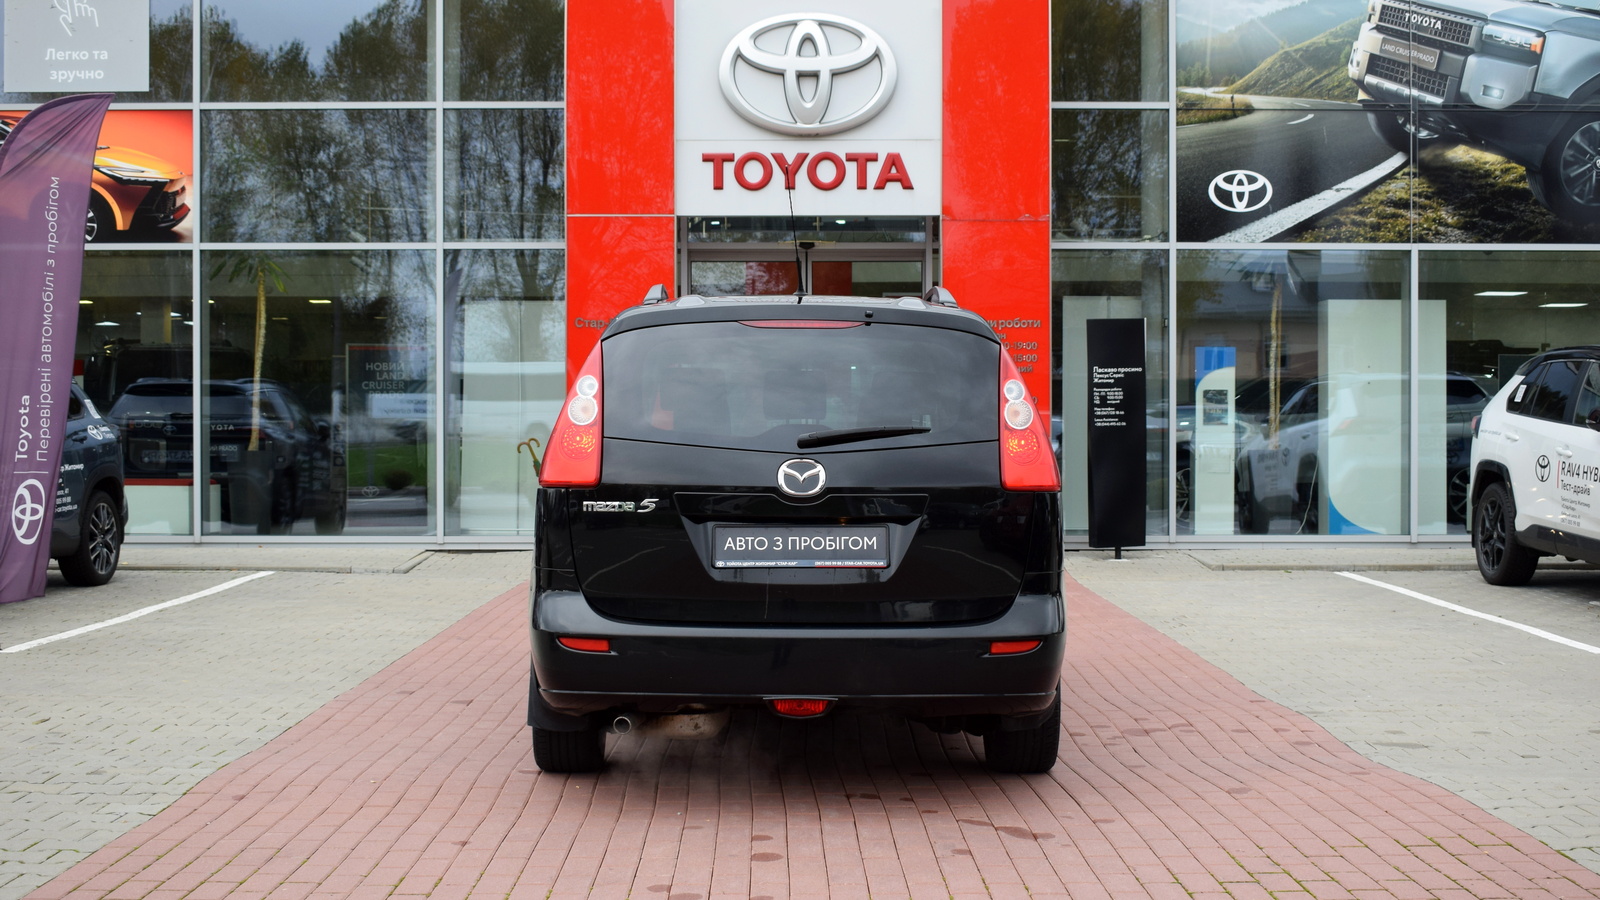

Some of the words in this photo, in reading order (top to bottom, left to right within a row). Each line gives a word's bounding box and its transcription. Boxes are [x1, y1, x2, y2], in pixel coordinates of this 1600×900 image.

[1404, 13, 1442, 30] TOYOTA
[45, 48, 89, 60] Легко
[92, 50, 108, 60] та
[1382, 43, 1395, 52] LAND
[1396, 46, 1417, 57] CRUISER
[1417, 52, 1435, 63] PRADO
[50, 70, 104, 83] зручно
[702, 151, 914, 191] TOYOTA
[45, 176, 60, 253] пробігом
[47, 259, 55, 267] з
[42, 272, 54, 362] автомобілі
[575, 317, 614, 330] Стар-
[999, 318, 1041, 330] роботи
[365, 360, 405, 371] НОВИЙ
[376, 371, 405, 380] LAND
[361, 381, 405, 390] CRUISER
[368, 390, 405, 399] PRADO
[37, 368, 53, 461] Перевірені
[15, 395, 32, 462] Toyota
[1561, 461, 1581, 479] RAV4
[1582, 464, 1600, 483] HYB
[1561, 479, 1591, 496] Тест-драйв
[637, 499, 659, 513] 5
[724, 536, 768, 551] АВТО
[773, 537, 783, 551] З
[788, 536, 877, 550] ПРОБІГОМ
